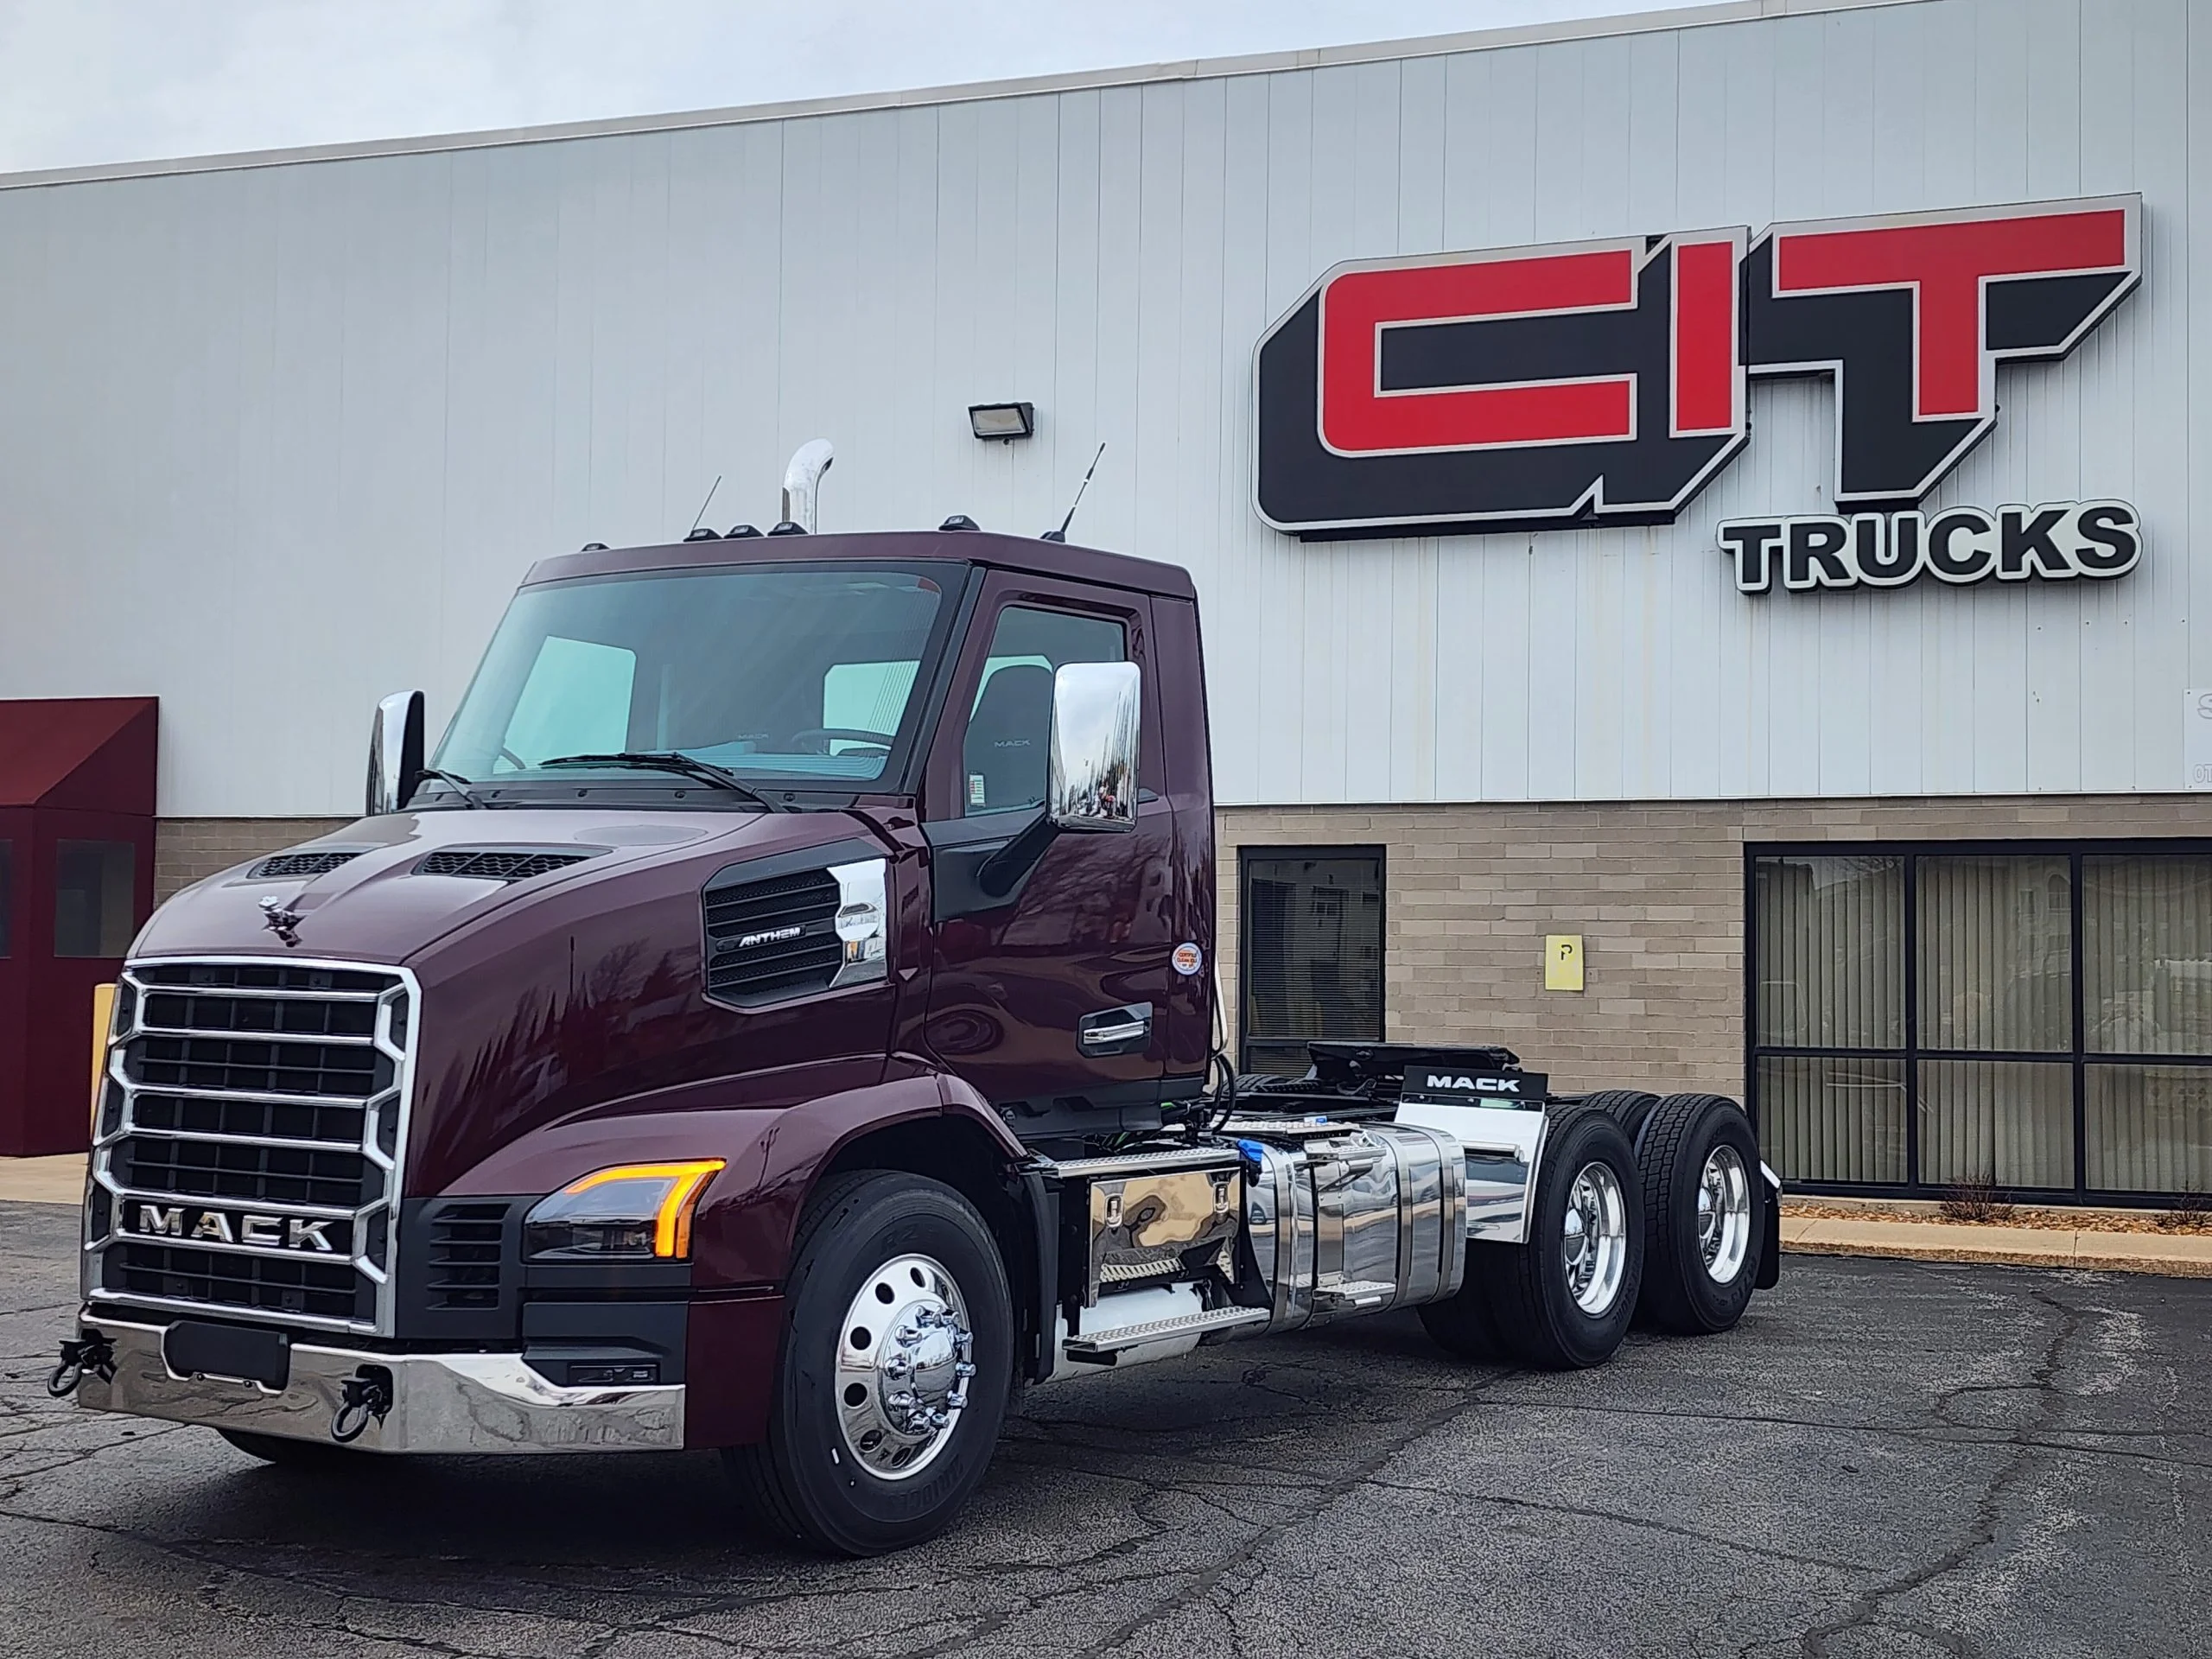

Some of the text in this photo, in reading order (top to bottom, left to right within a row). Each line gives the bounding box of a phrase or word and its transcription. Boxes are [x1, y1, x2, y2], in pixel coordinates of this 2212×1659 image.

[1317, 202, 2131, 458] CIT
[1722, 506, 2138, 585] TRUCKS
[994, 739, 1031, 748] MACK
[738, 926, 801, 948] ANTHEM
[1427, 1075, 1521, 1093] MACK
[138, 1205, 334, 1251] MACK
